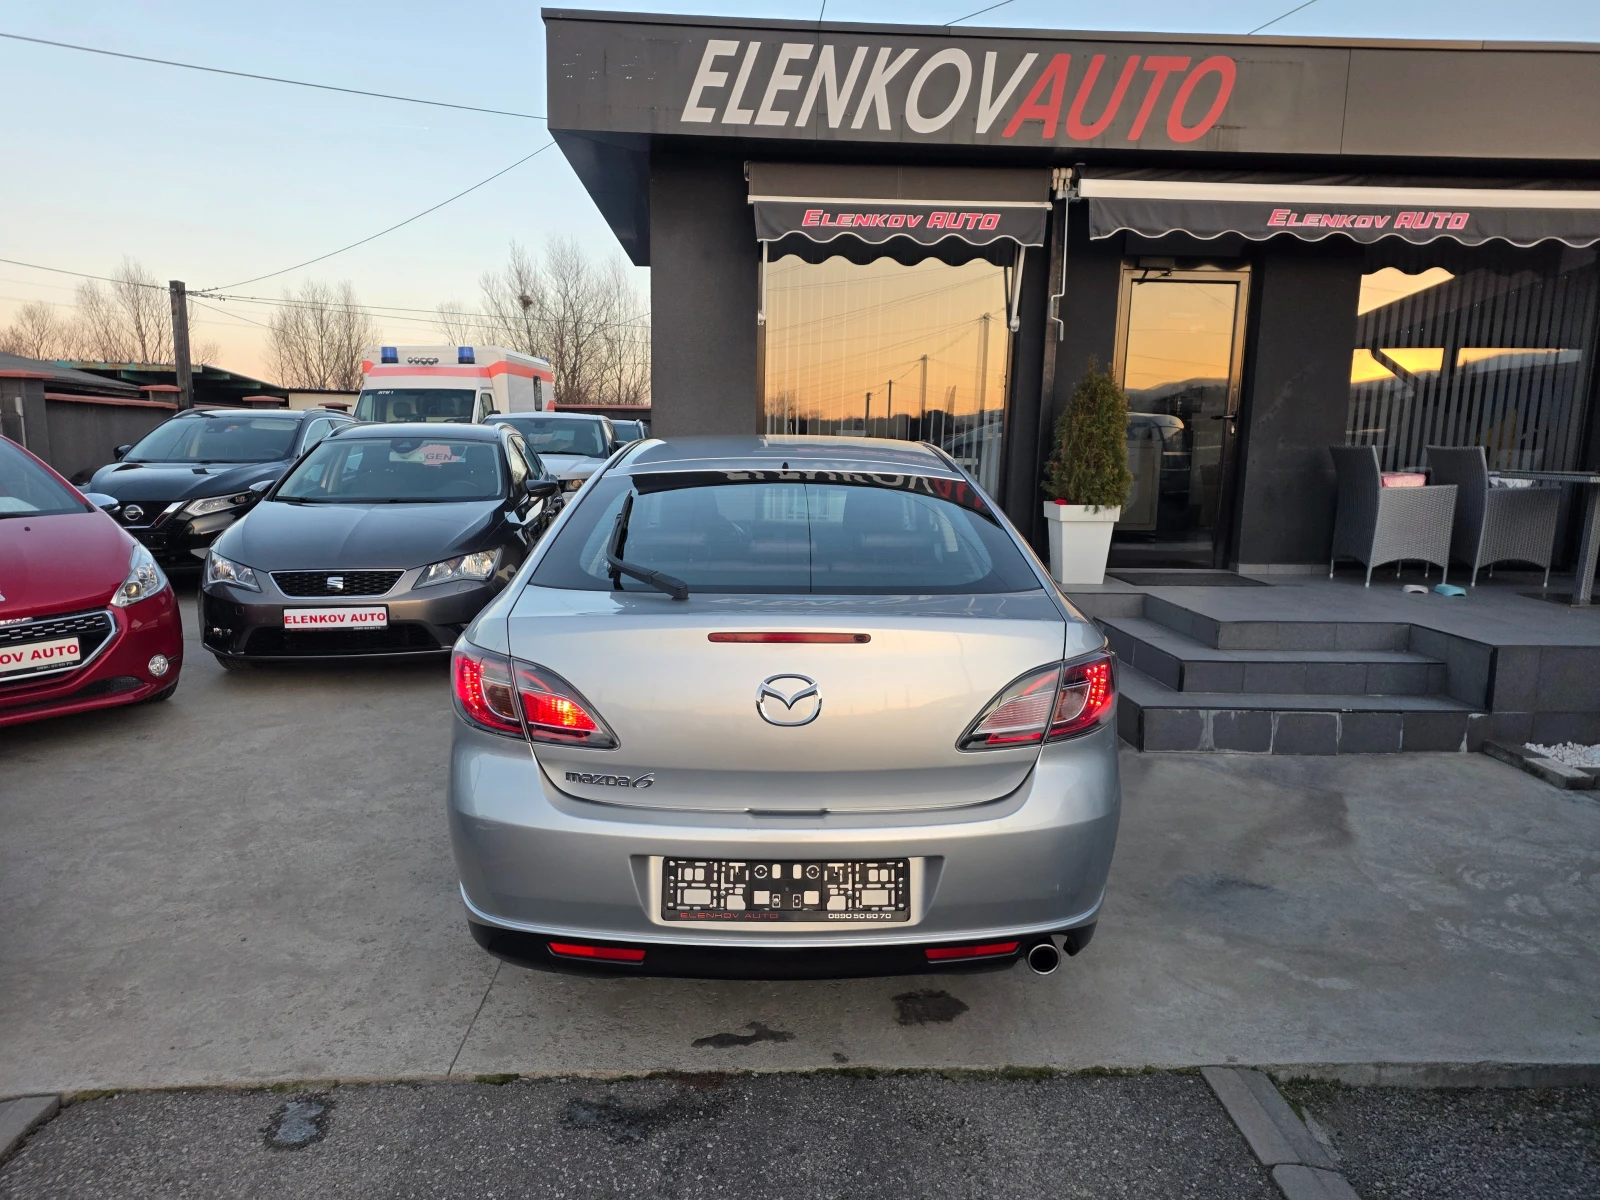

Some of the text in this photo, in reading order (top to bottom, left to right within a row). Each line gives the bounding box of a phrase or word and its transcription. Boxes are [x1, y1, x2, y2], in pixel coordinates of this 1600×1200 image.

[926, 211, 1001, 230] AUTO
[1393, 211, 1470, 230] AUTO
[284, 613, 386, 624] ELENKOV AUTO
[31, 645, 78, 660] AUTO
